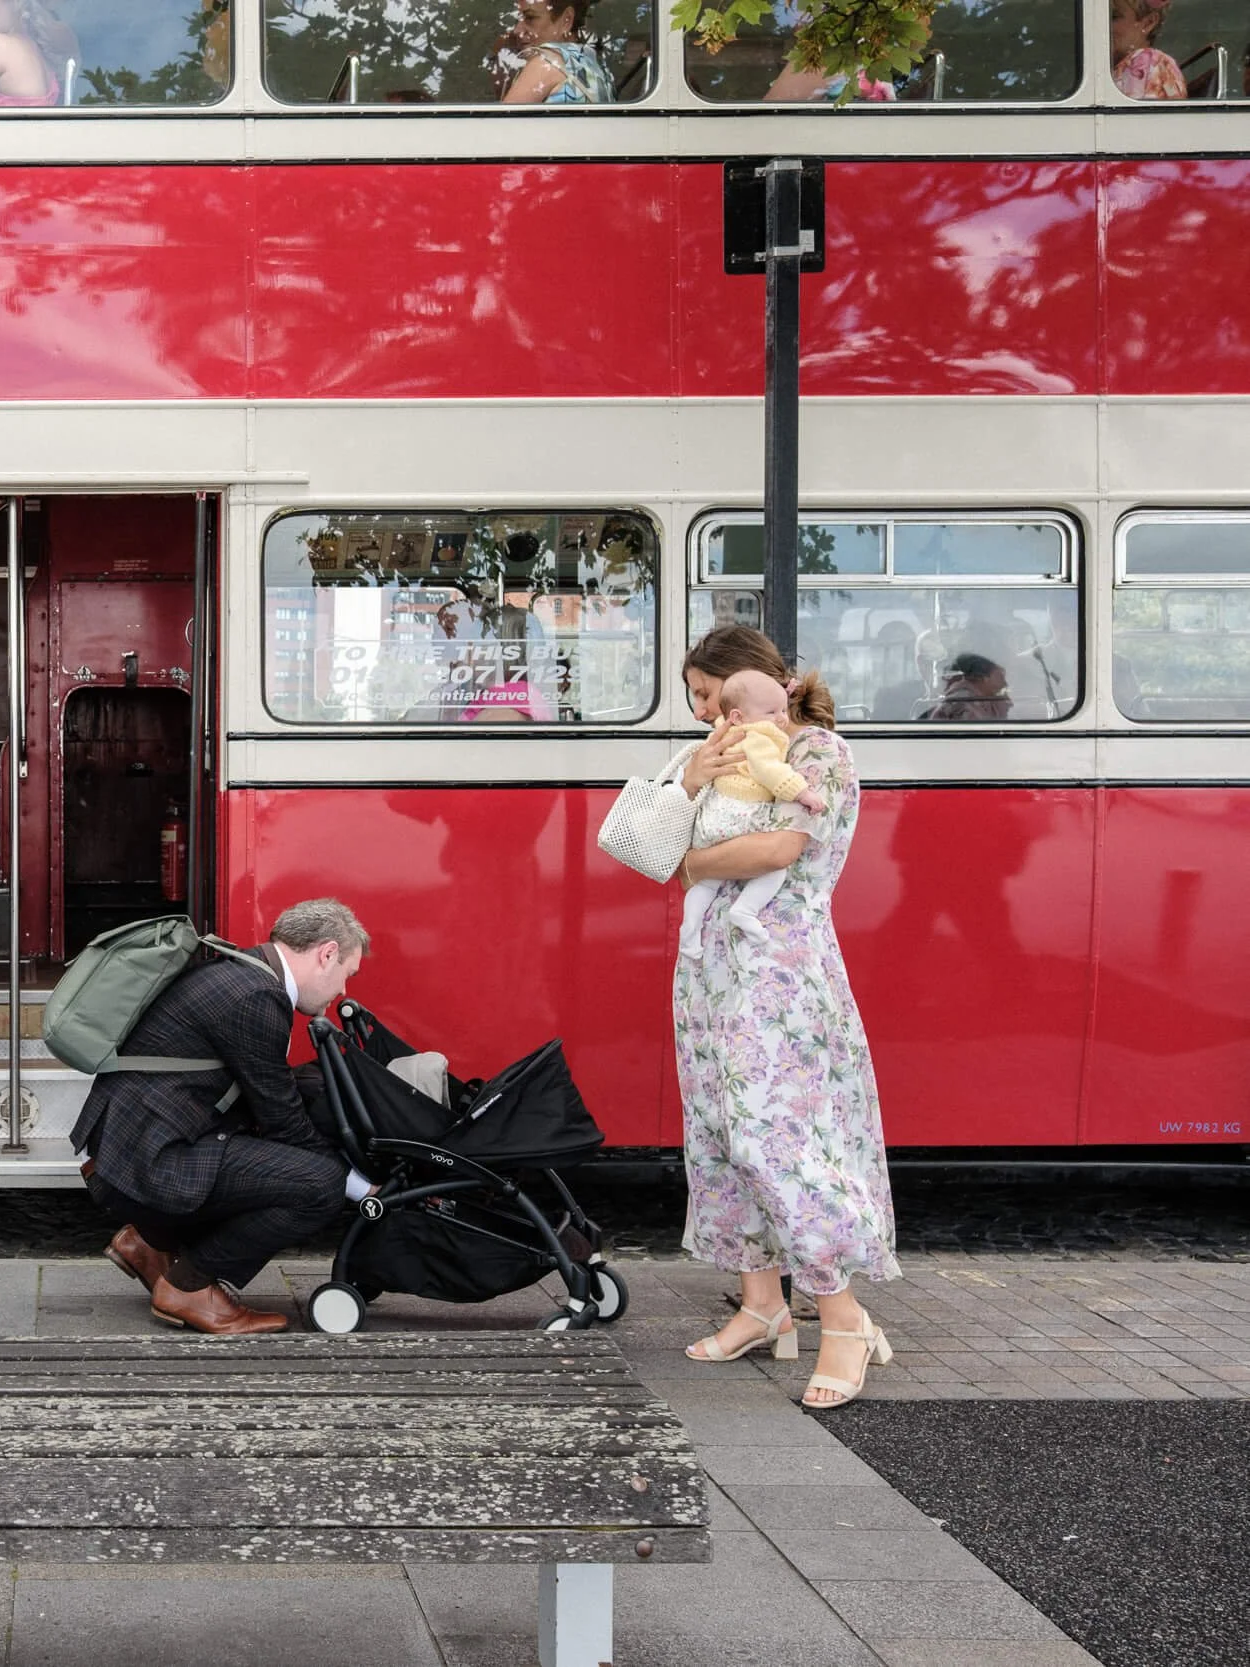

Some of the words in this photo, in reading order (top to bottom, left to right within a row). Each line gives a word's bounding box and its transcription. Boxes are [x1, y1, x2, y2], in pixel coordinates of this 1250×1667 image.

[455, 645, 522, 660] THIS
[1159, 1121, 1183, 1133] UW
[1223, 1121, 1241, 1134] KG
